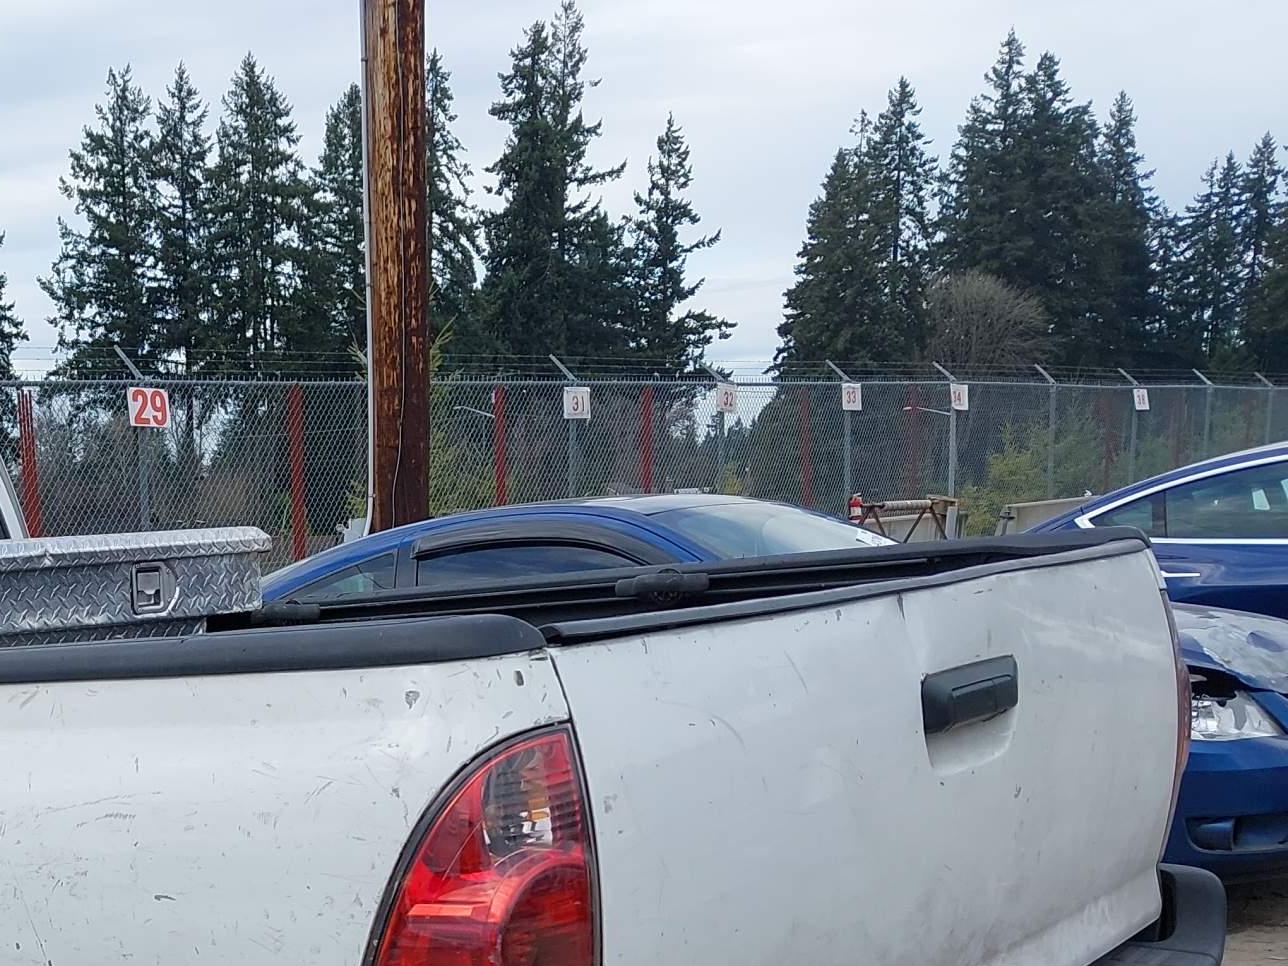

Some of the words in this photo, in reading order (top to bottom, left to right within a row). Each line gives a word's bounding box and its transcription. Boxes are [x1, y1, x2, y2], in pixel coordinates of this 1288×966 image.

[572, 395, 585, 412] 31
[723, 391, 734, 406] 32
[846, 390, 857, 404] 33
[132, 389, 167, 426] 29
